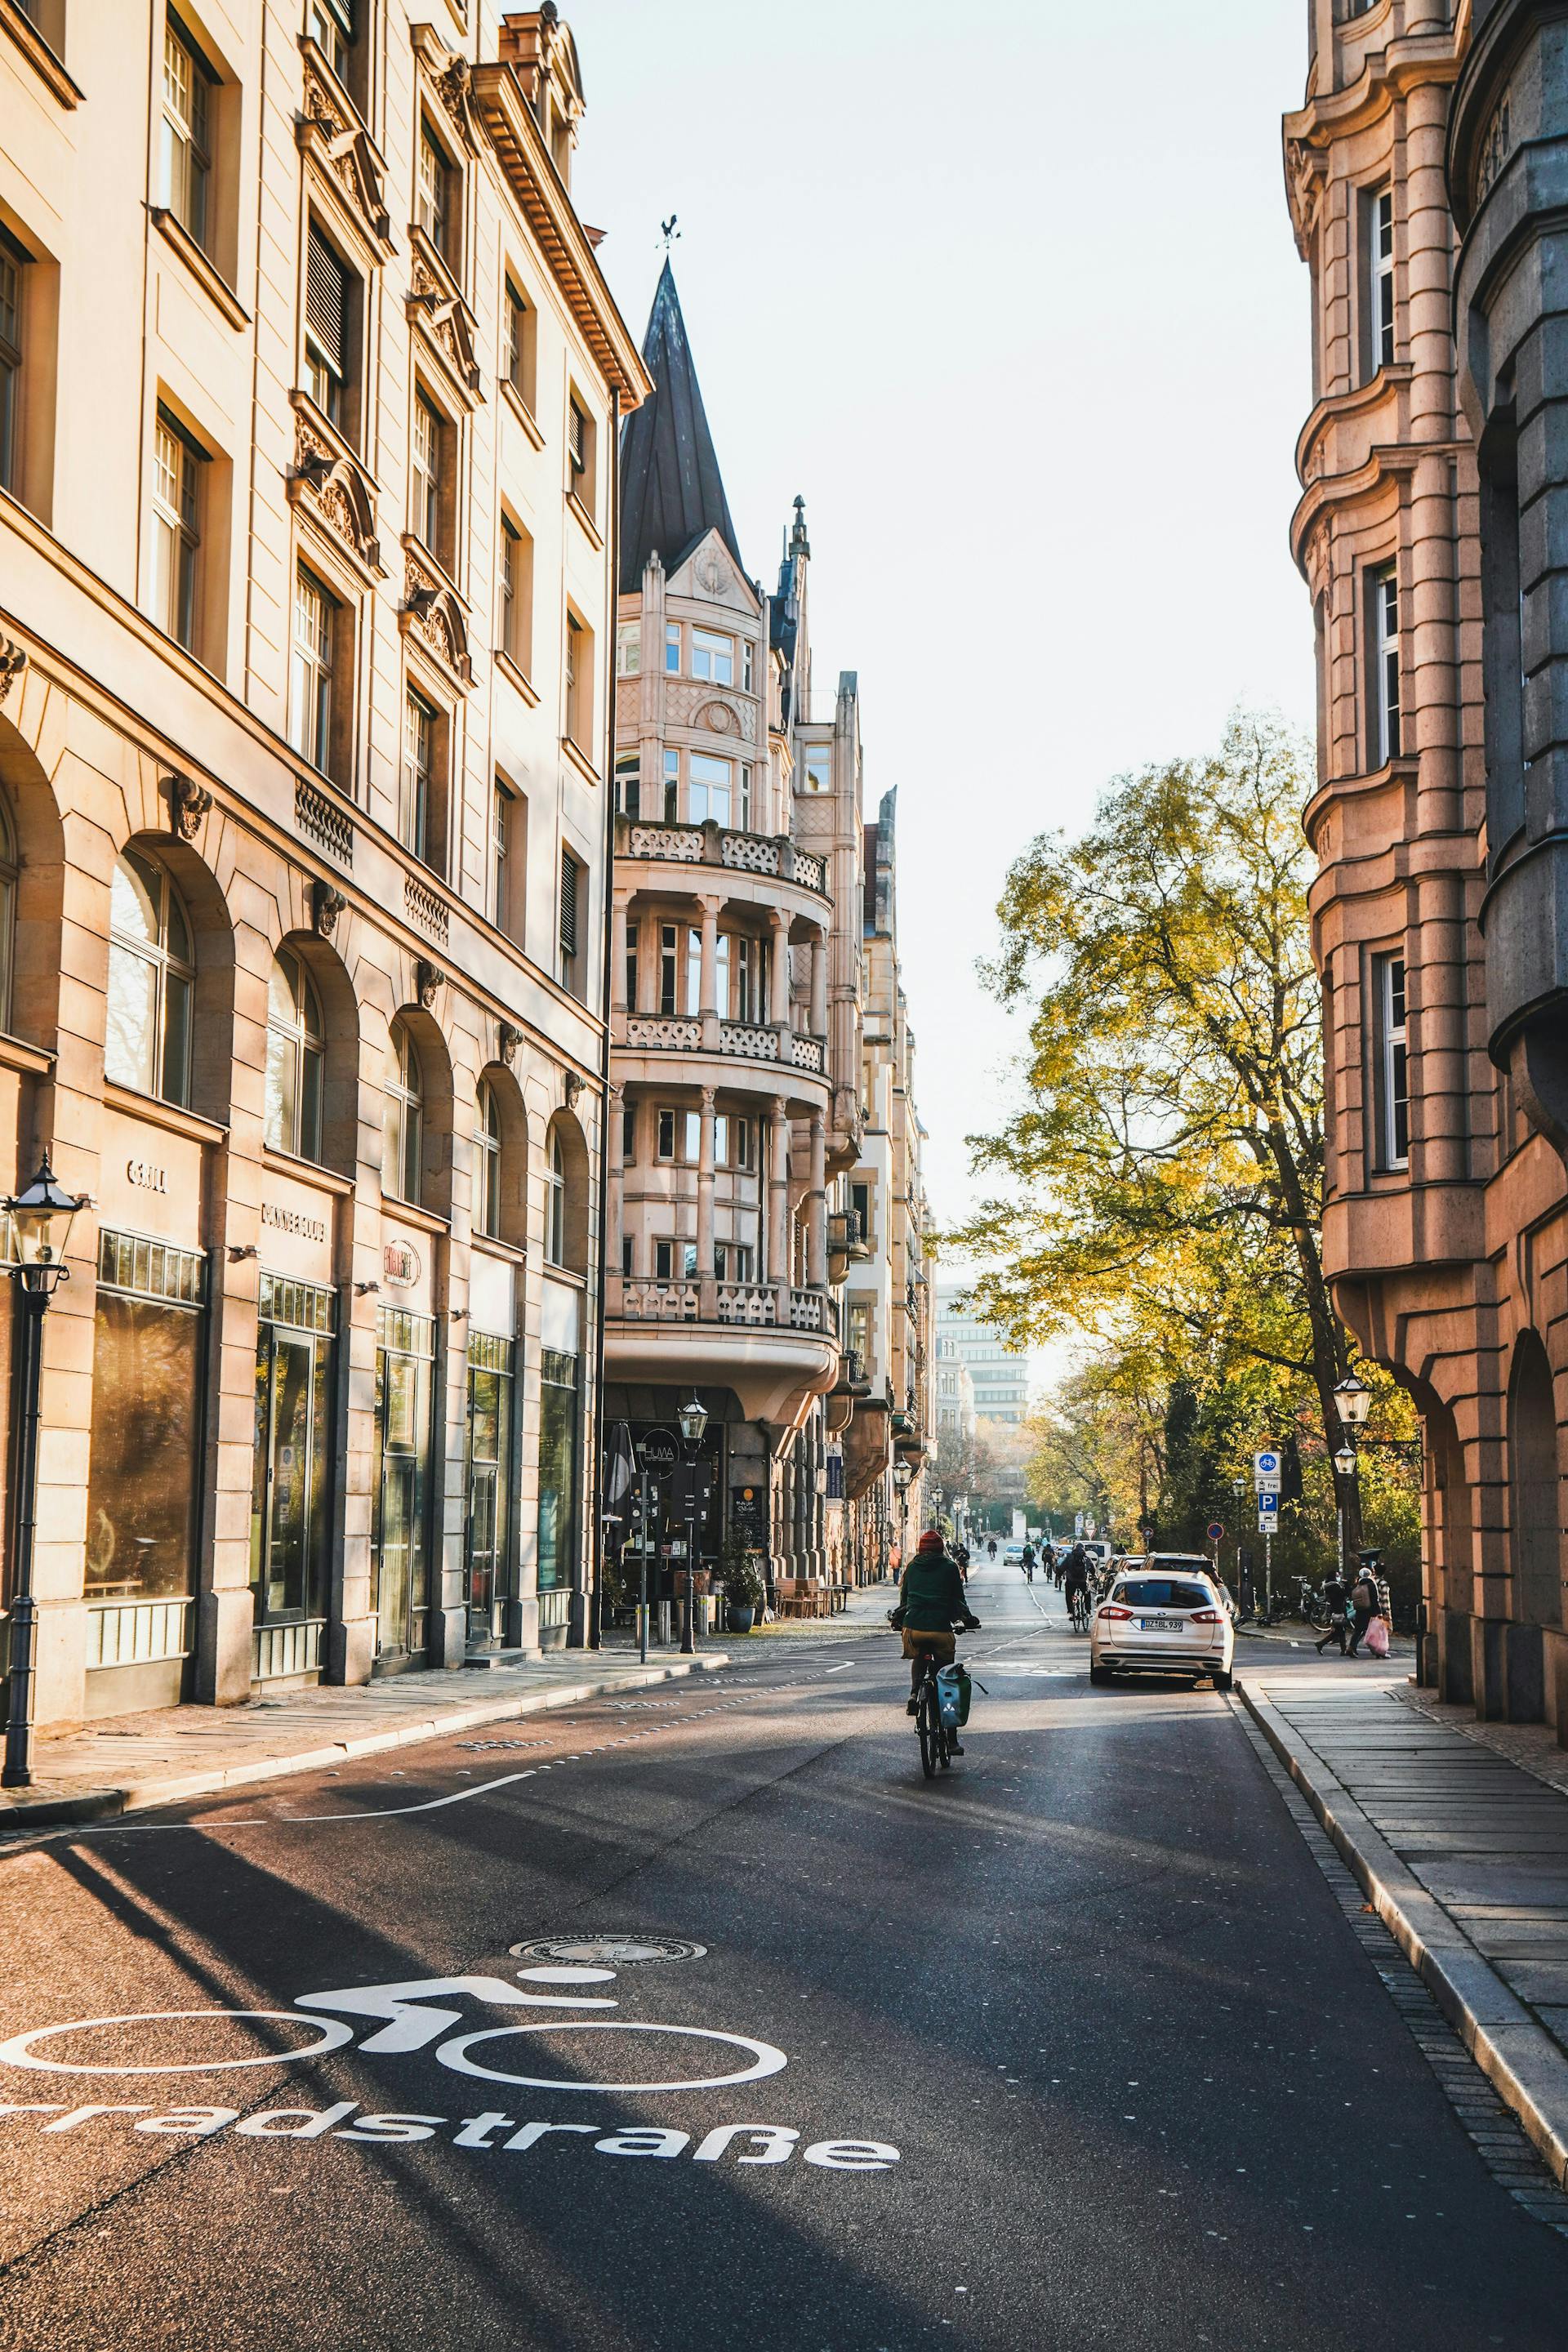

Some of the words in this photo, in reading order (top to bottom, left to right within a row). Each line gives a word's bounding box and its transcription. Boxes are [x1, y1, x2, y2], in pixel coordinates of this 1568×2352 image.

[644, 1446, 675, 1458] HUMA
[1263, 1494, 1273, 1510] P
[1169, 1621, 1182, 1629] 939
